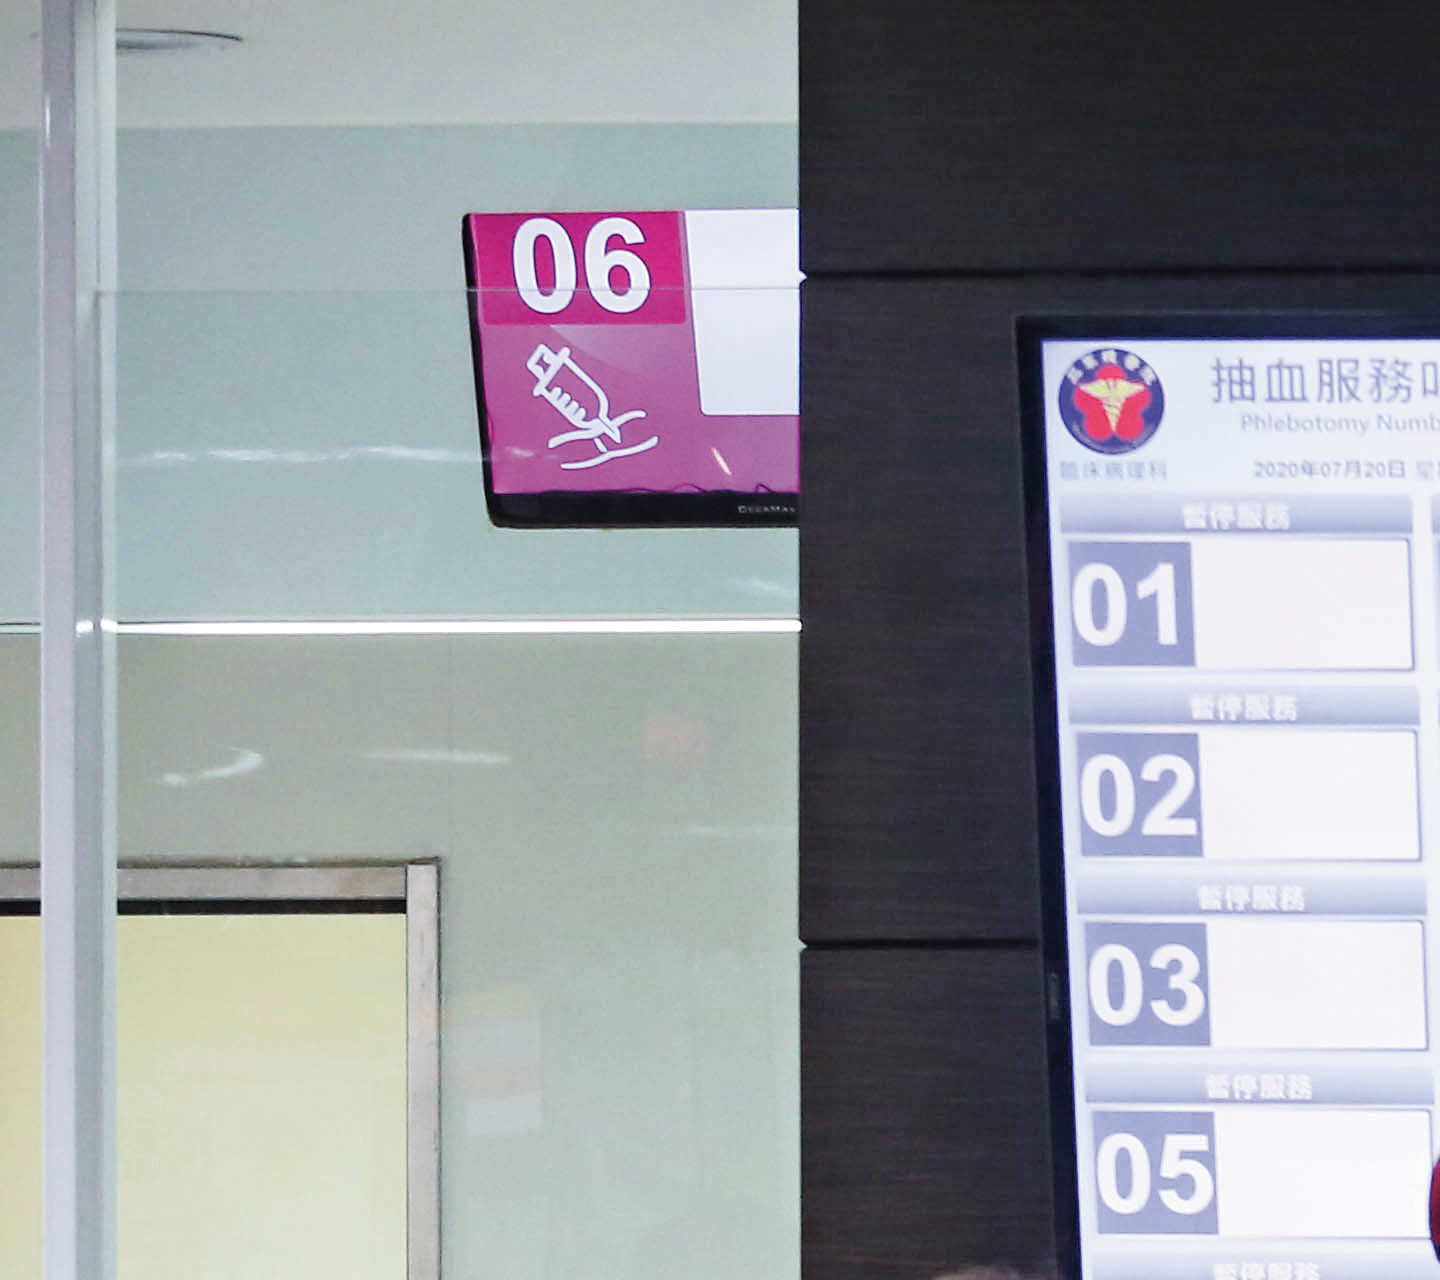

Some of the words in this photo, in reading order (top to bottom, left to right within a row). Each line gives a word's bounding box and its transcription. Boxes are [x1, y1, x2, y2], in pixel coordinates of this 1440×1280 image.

[512, 217, 651, 314] 06
[1241, 413, 1369, 434] Phlebotomy
[1072, 563, 1180, 648] 01
[1079, 753, 1198, 838] 02
[1088, 944, 1205, 1027] 03
[1096, 1132, 1214, 1217] 05
